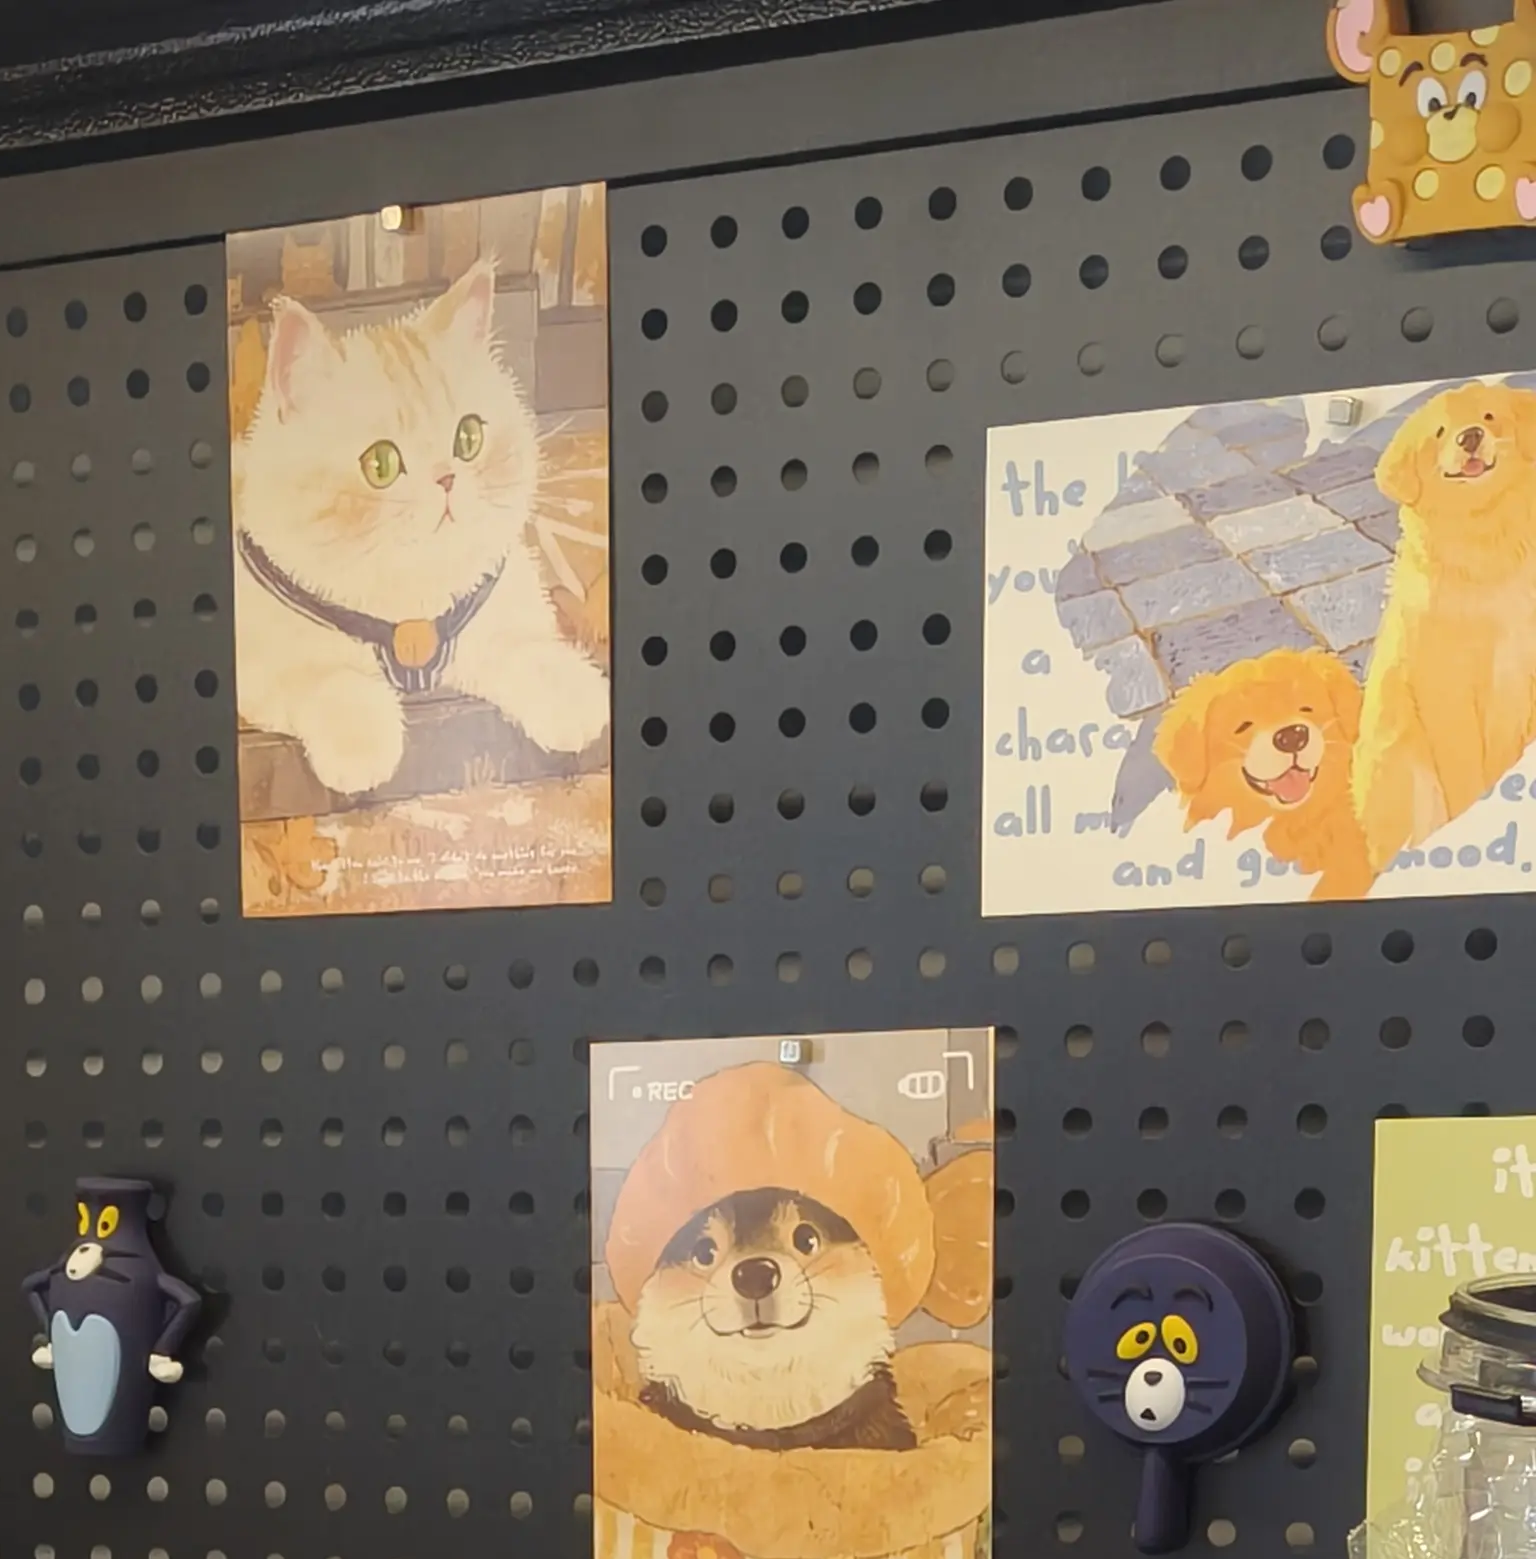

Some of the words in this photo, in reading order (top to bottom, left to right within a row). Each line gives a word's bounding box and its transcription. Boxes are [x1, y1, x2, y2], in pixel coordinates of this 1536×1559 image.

[1001, 459, 1086, 517] the
[1021, 648, 1052, 674] a
[994, 784, 1051, 837] all
[1112, 838, 1205, 887] and
